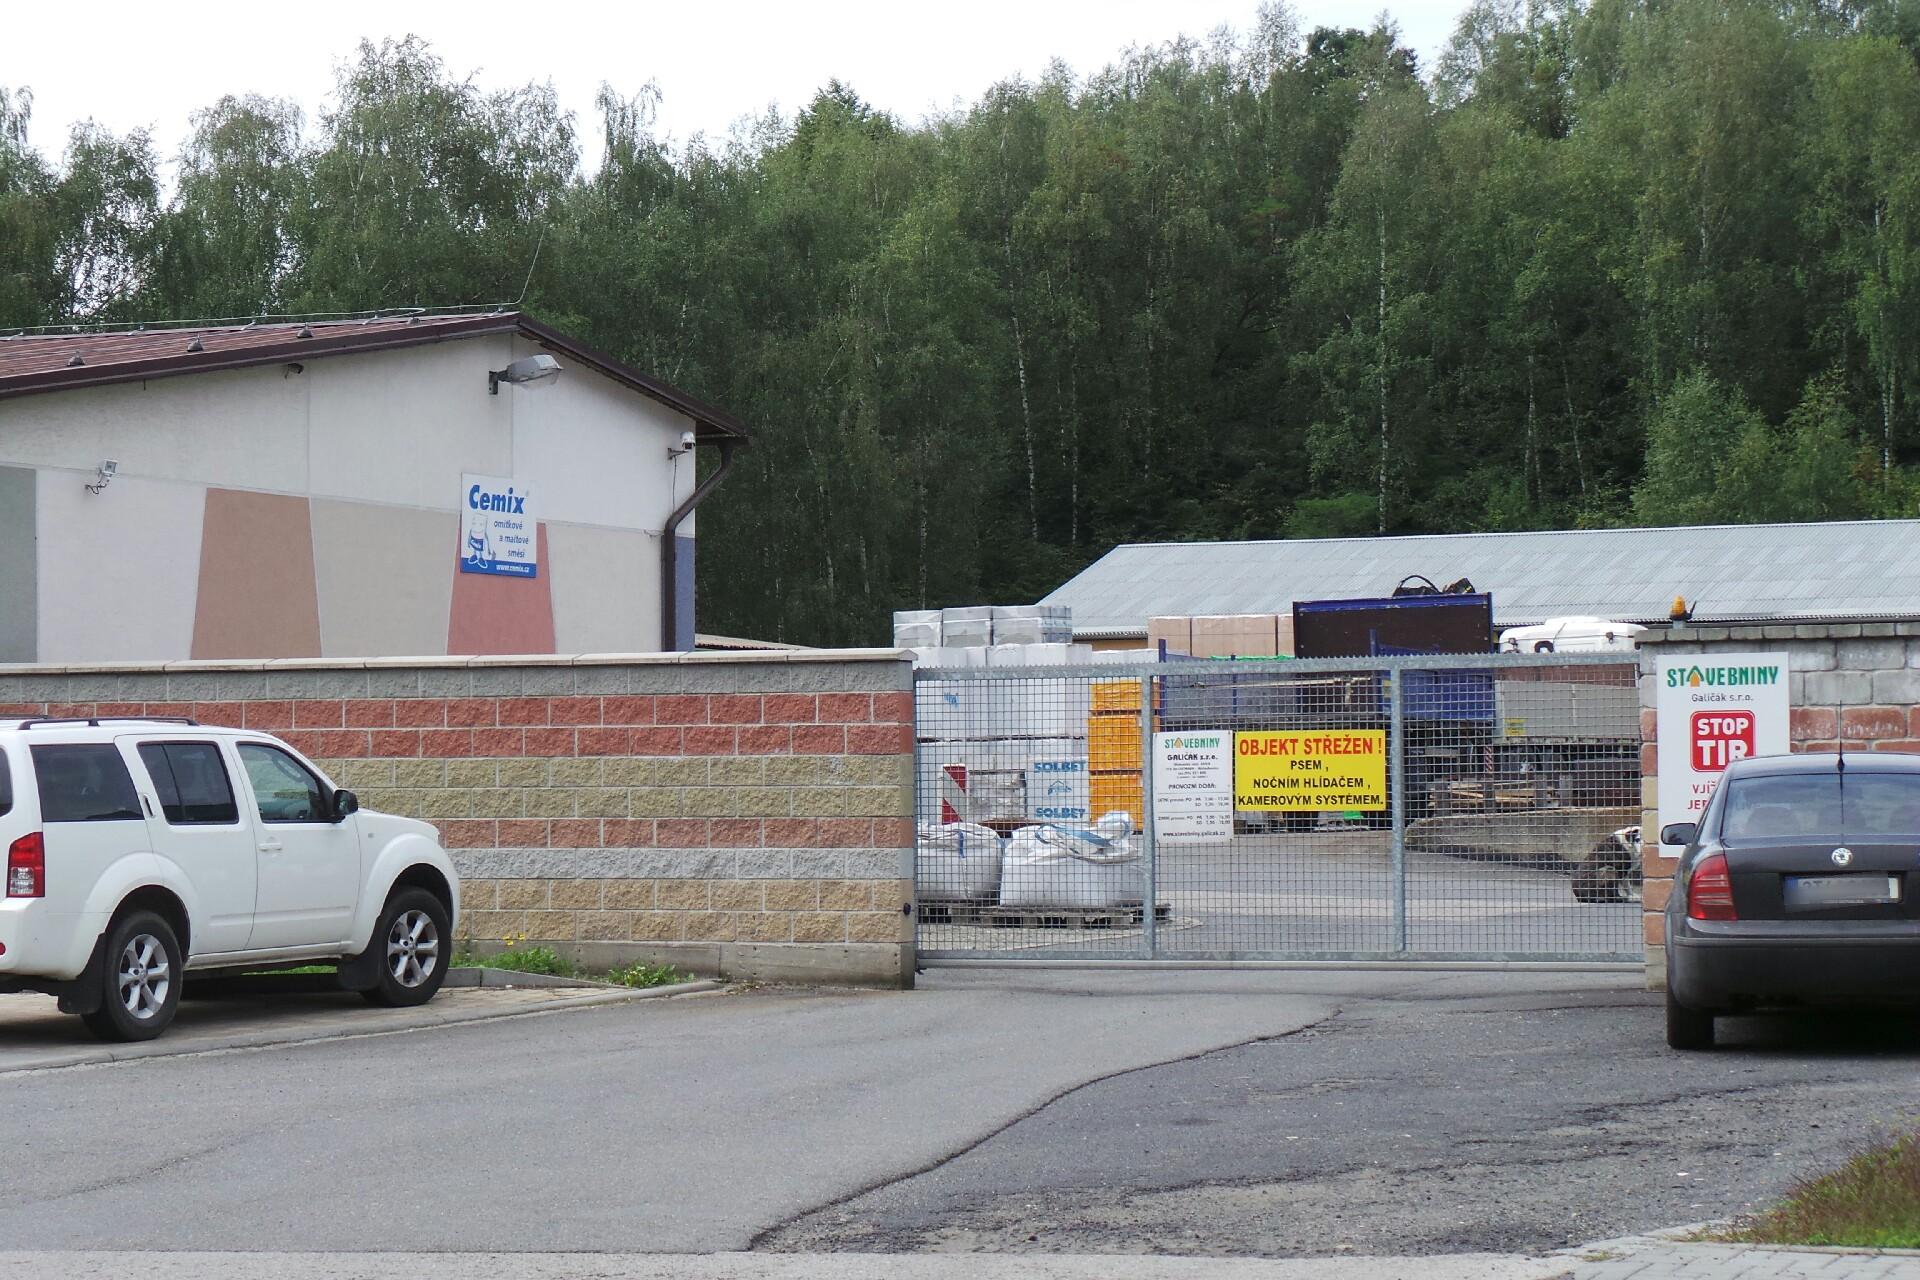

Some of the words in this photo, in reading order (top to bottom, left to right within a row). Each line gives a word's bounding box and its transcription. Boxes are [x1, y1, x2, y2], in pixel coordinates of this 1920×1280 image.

[469, 485, 524, 514] Cemix
[1667, 665, 1778, 687] STAVEBNINY
[1691, 693, 1726, 702] Galičák
[1729, 694, 1754, 702] s.r.o.
[1697, 718, 1749, 736] STOP
[1164, 737, 1221, 749] STAVEBNINY
[1239, 739, 1299, 755] OBJEKT
[1303, 734, 1373, 755] STŘEŽEN
[1697, 740, 1748, 766] TIR
[1033, 761, 1087, 774] SOLBET
[1290, 760, 1322, 770] PSEM
[1253, 776, 1300, 788] NOČNÍM
[1303, 776, 1364, 788] HLÍDAČEM
[1238, 794, 1312, 805] KAMEROVÝM
[1315, 794, 1384, 805] SYSTÉMEM.
[1035, 808, 1086, 819] SOLBET
